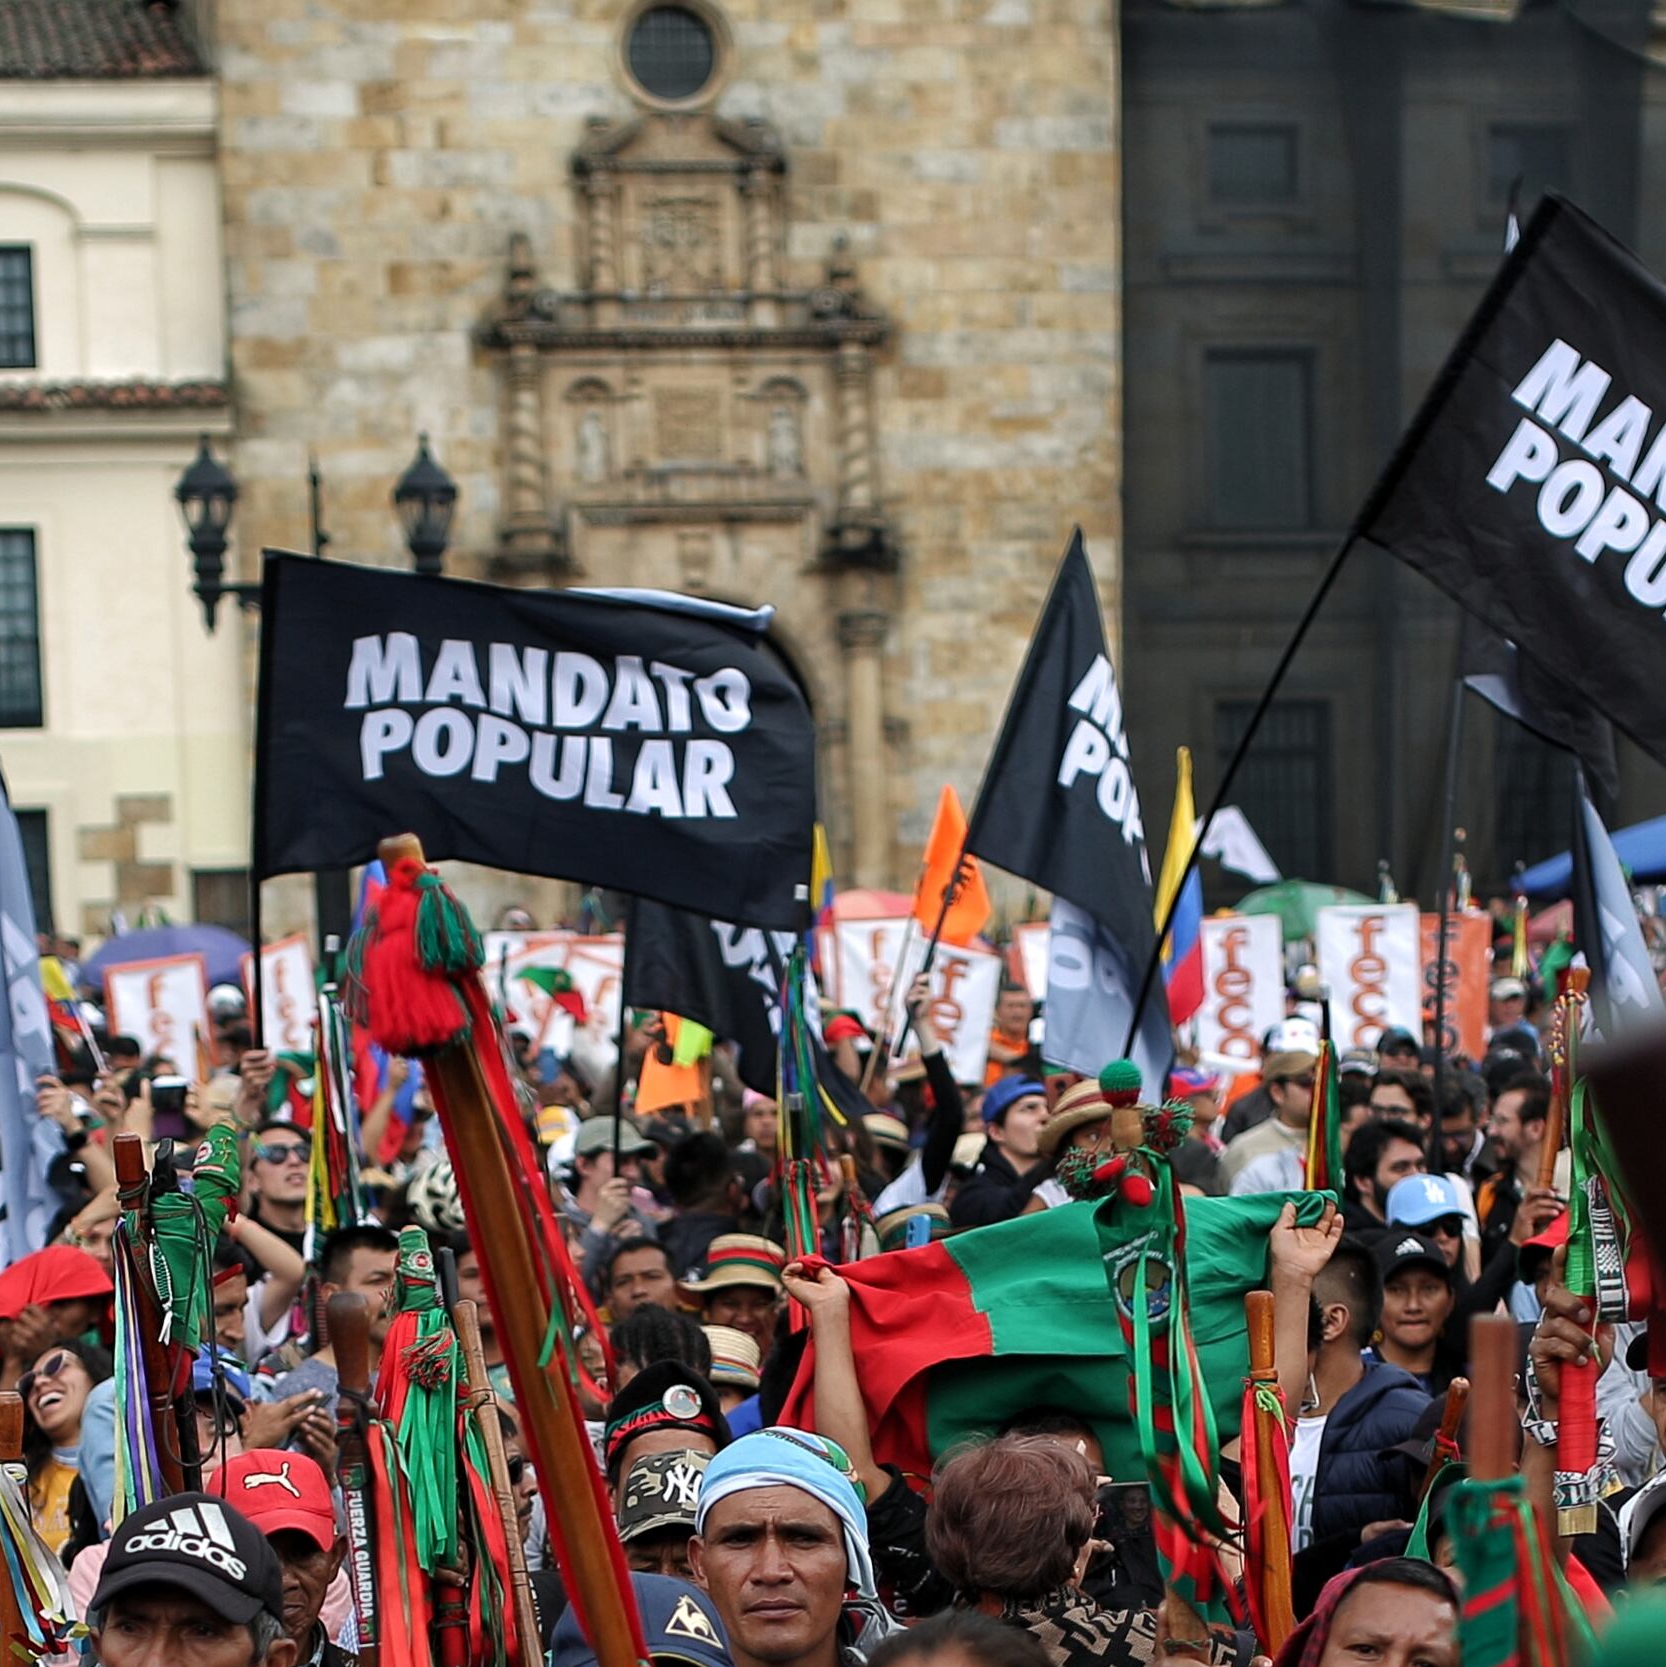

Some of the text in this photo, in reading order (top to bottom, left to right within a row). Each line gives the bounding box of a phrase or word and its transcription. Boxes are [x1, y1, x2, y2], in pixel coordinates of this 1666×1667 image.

[343, 631, 752, 734] MANDATO
[361, 706, 738, 818] POPULAR
[125, 1519, 248, 1581] adidas
[347, 1490, 367, 1548] FUERZA
[355, 1551, 374, 1619] GUARDIA
